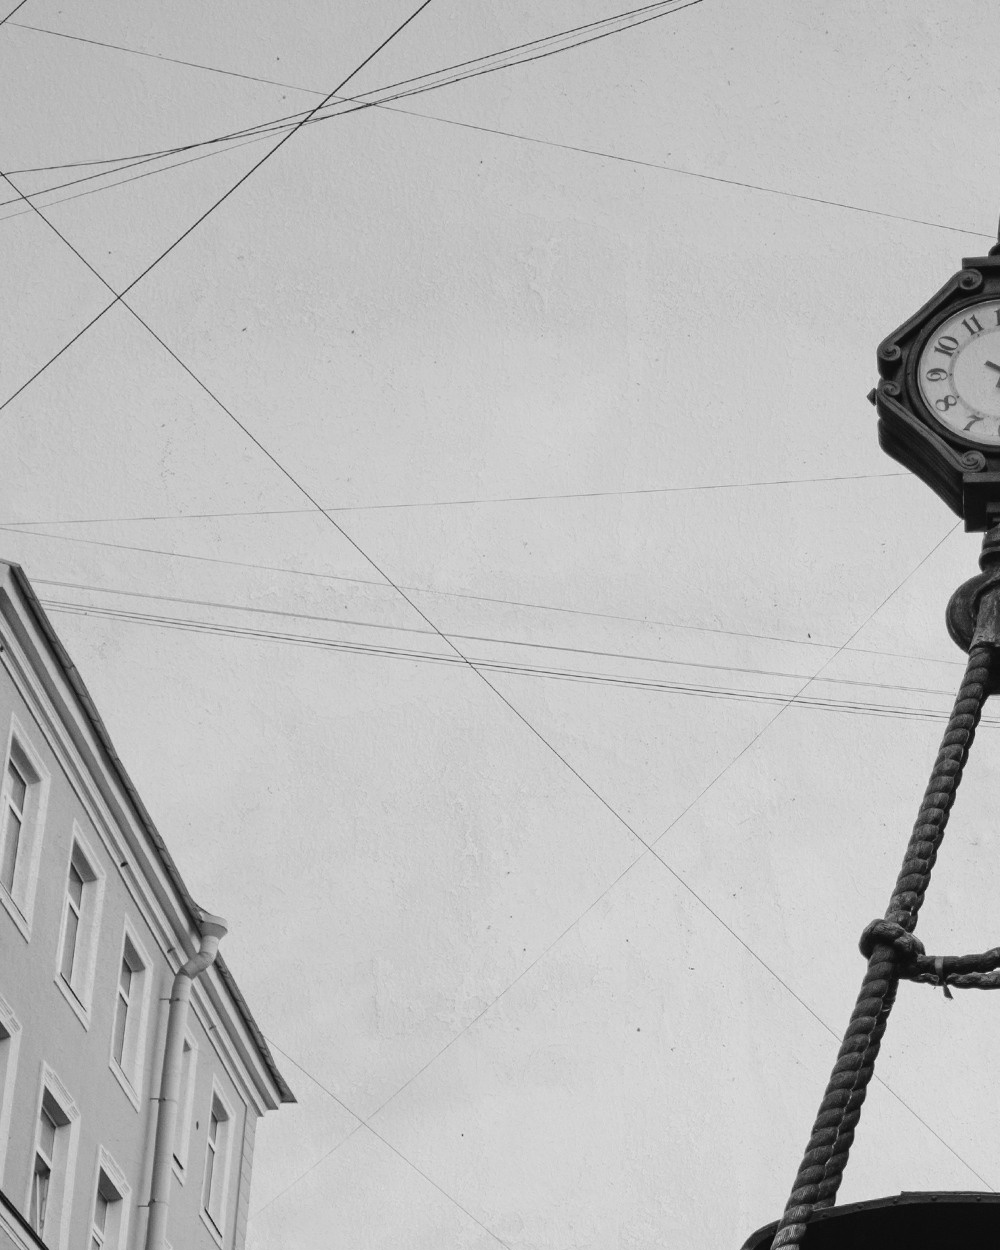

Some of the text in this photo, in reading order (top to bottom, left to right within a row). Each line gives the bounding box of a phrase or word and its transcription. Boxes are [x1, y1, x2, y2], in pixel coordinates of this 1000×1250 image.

[961, 314, 984, 335] 11
[933, 335, 959, 357] 10
[926, 368, 948, 382] 9
[935, 395, 957, 412] 8
[963, 414, 984, 431] 7
